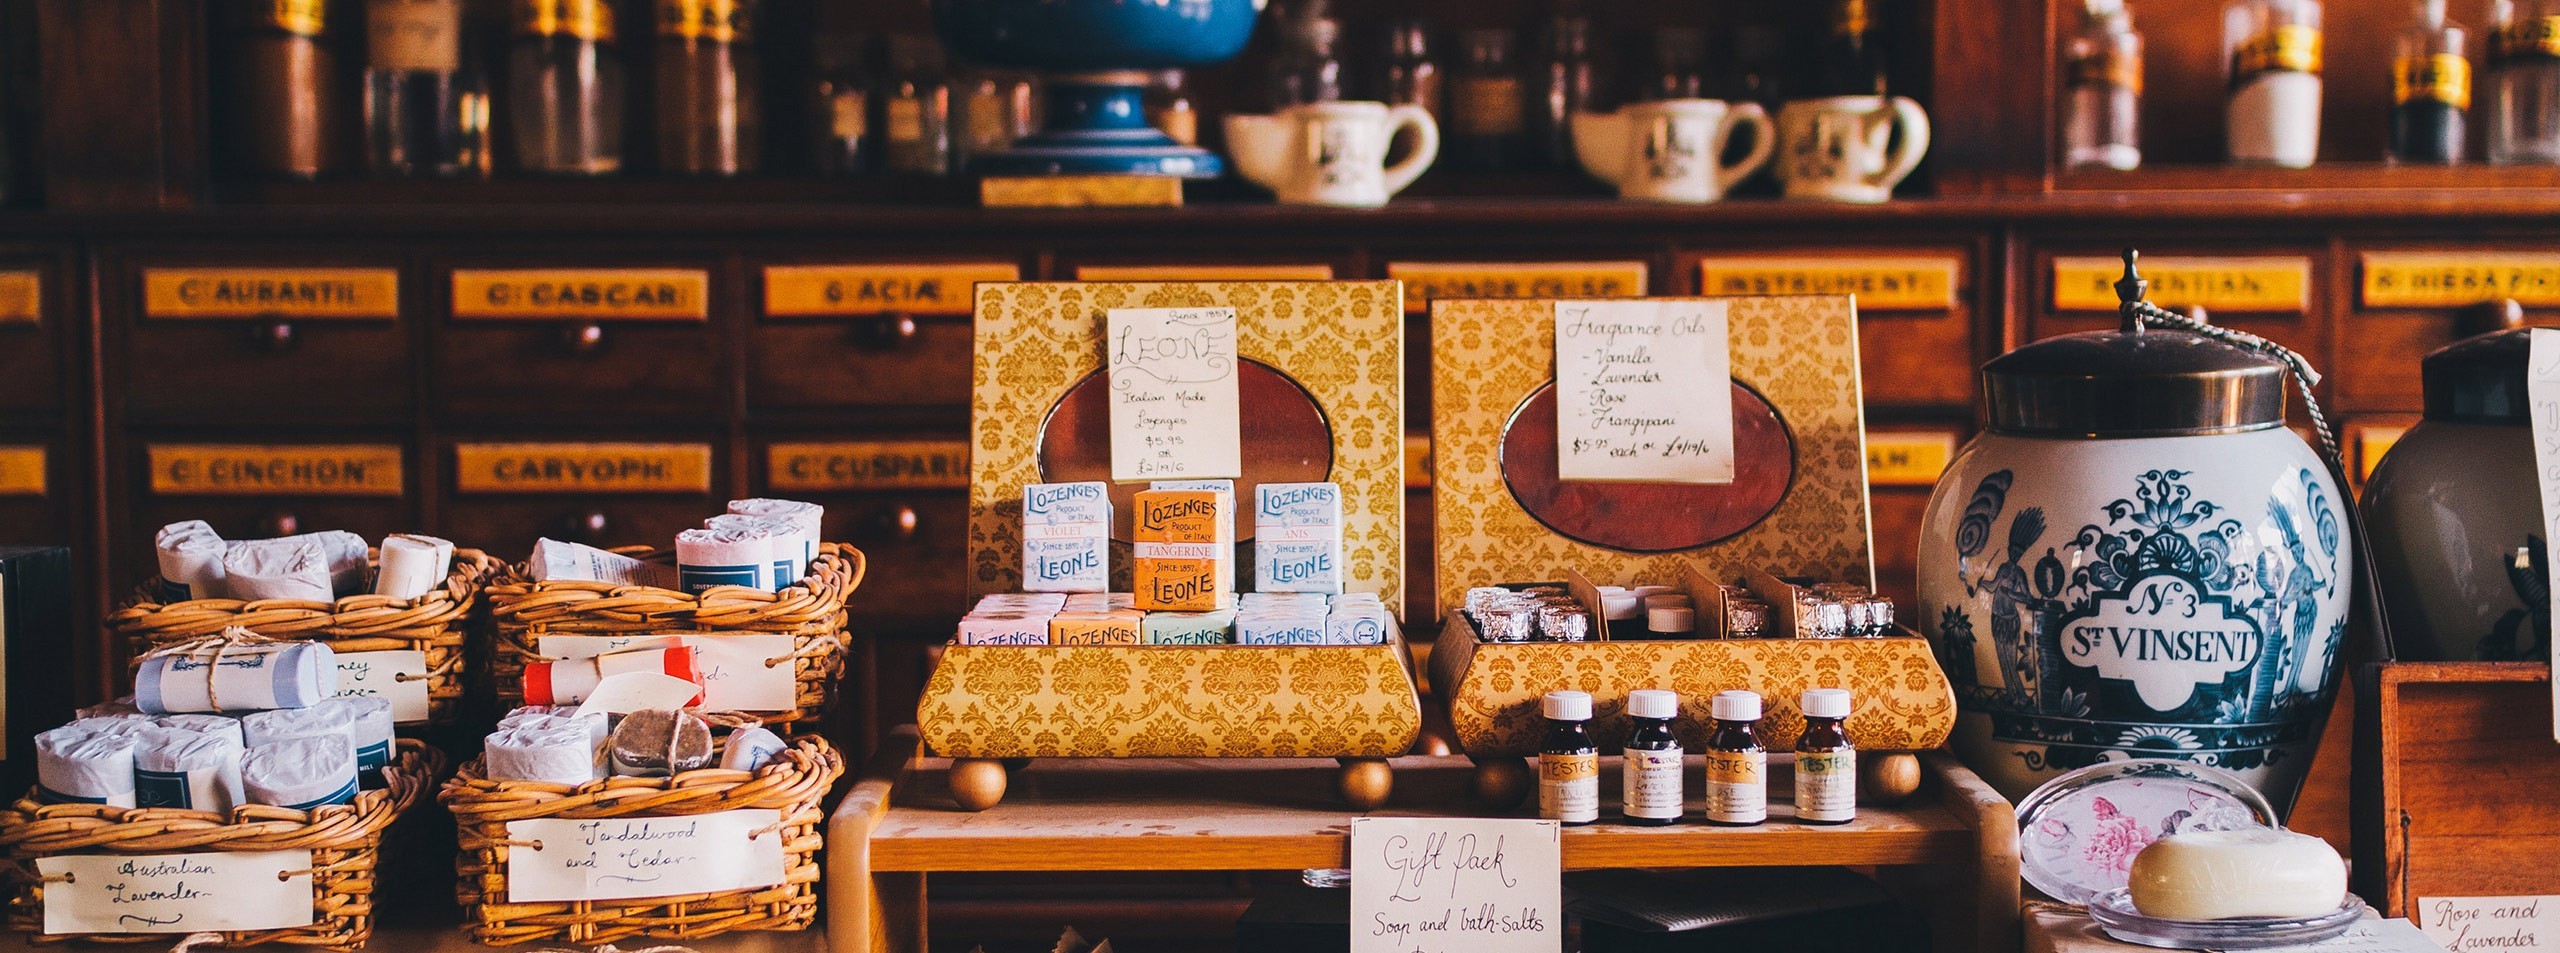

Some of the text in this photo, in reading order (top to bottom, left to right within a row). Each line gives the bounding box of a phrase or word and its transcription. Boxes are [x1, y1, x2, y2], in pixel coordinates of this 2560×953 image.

[1169, 310, 1228, 321] Since 1857
[1565, 308, 1706, 346] Fragrance Oils
[1114, 325, 1229, 364] LEONE
[1122, 390, 1208, 408] Italian Made
[1134, 409, 1188, 430] Lozenges
[1609, 442, 1638, 458] each
[1027, 484, 1100, 514] LOZENGES
[1262, 487, 1335, 517] LOZENGES
[1143, 499, 1216, 531] LOZENGES
[1044, 526, 1083, 536] VIOLET
[1283, 529, 1309, 539] ANIS
[1147, 545, 1212, 557] TANGERINE
[1039, 550, 1100, 581] LEONE
[1273, 553, 1333, 583] LEONE
[1153, 573, 1215, 604] LEONE
[2182, 593, 2197, 618] 3
[2107, 626, 2255, 663] VINSENT
[1541, 759, 1595, 776] TESTER
[1706, 756, 1756, 775] TESTER
[1800, 756, 1852, 772] TESTER
[117, 859, 217, 878] Australian
[565, 851, 598, 869] and
[1384, 831, 1448, 902] Gift
[1373, 911, 1410, 946] Soap
[1419, 908, 1451, 931] and
[2435, 899, 2543, 931] Rose and
[2446, 923, 2540, 953] Lavender
